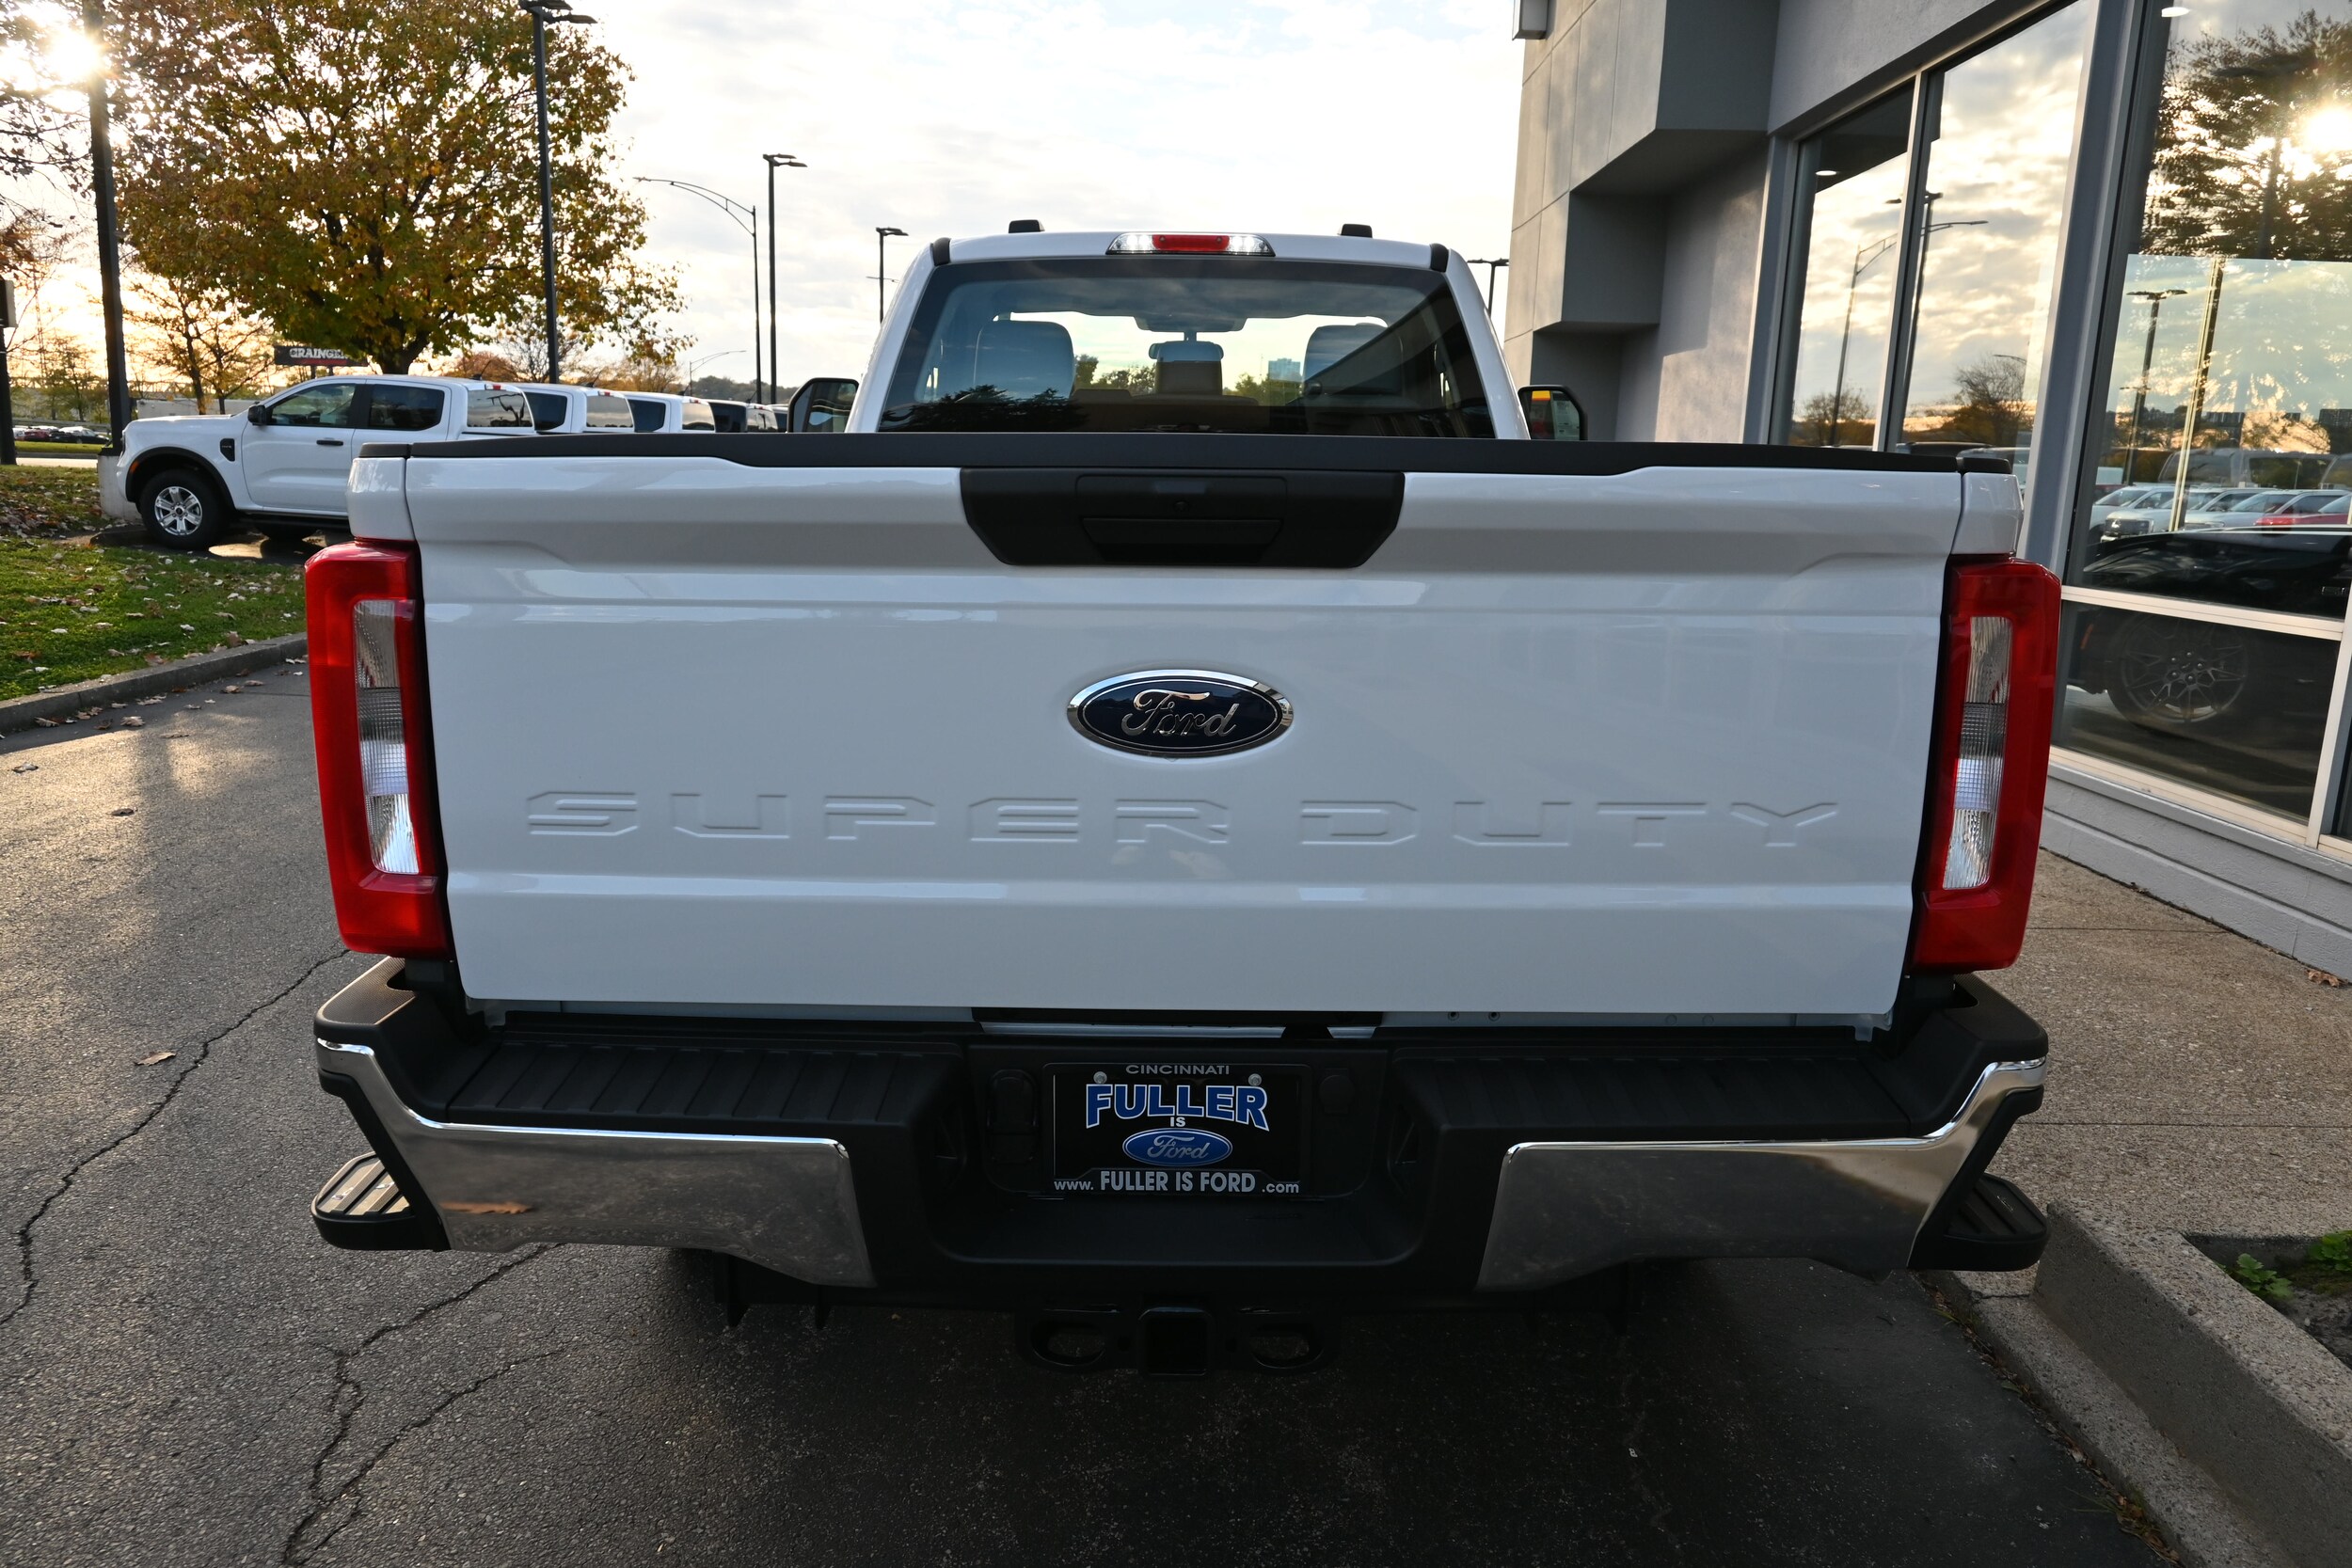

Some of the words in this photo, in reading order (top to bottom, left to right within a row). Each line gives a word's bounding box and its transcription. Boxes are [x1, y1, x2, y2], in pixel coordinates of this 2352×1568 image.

[289, 347, 348, 359] GRAINGE
[1120, 689, 1239, 737] Ford
[527, 791, 1228, 843] SUPER
[1300, 800, 1838, 847] DUTY
[1125, 1064, 1231, 1075] CINCINNATI
[1086, 1084, 1270, 1132] FULLER
[1169, 1117, 1186, 1128] IS
[1147, 1134, 1211, 1159] Ford
[1054, 1180, 1094, 1191] www.
[1100, 1170, 1168, 1192] FULLER
[1175, 1171, 1194, 1192] IS
[1200, 1172, 1256, 1193] FORD
[1262, 1182, 1299, 1195] .com
